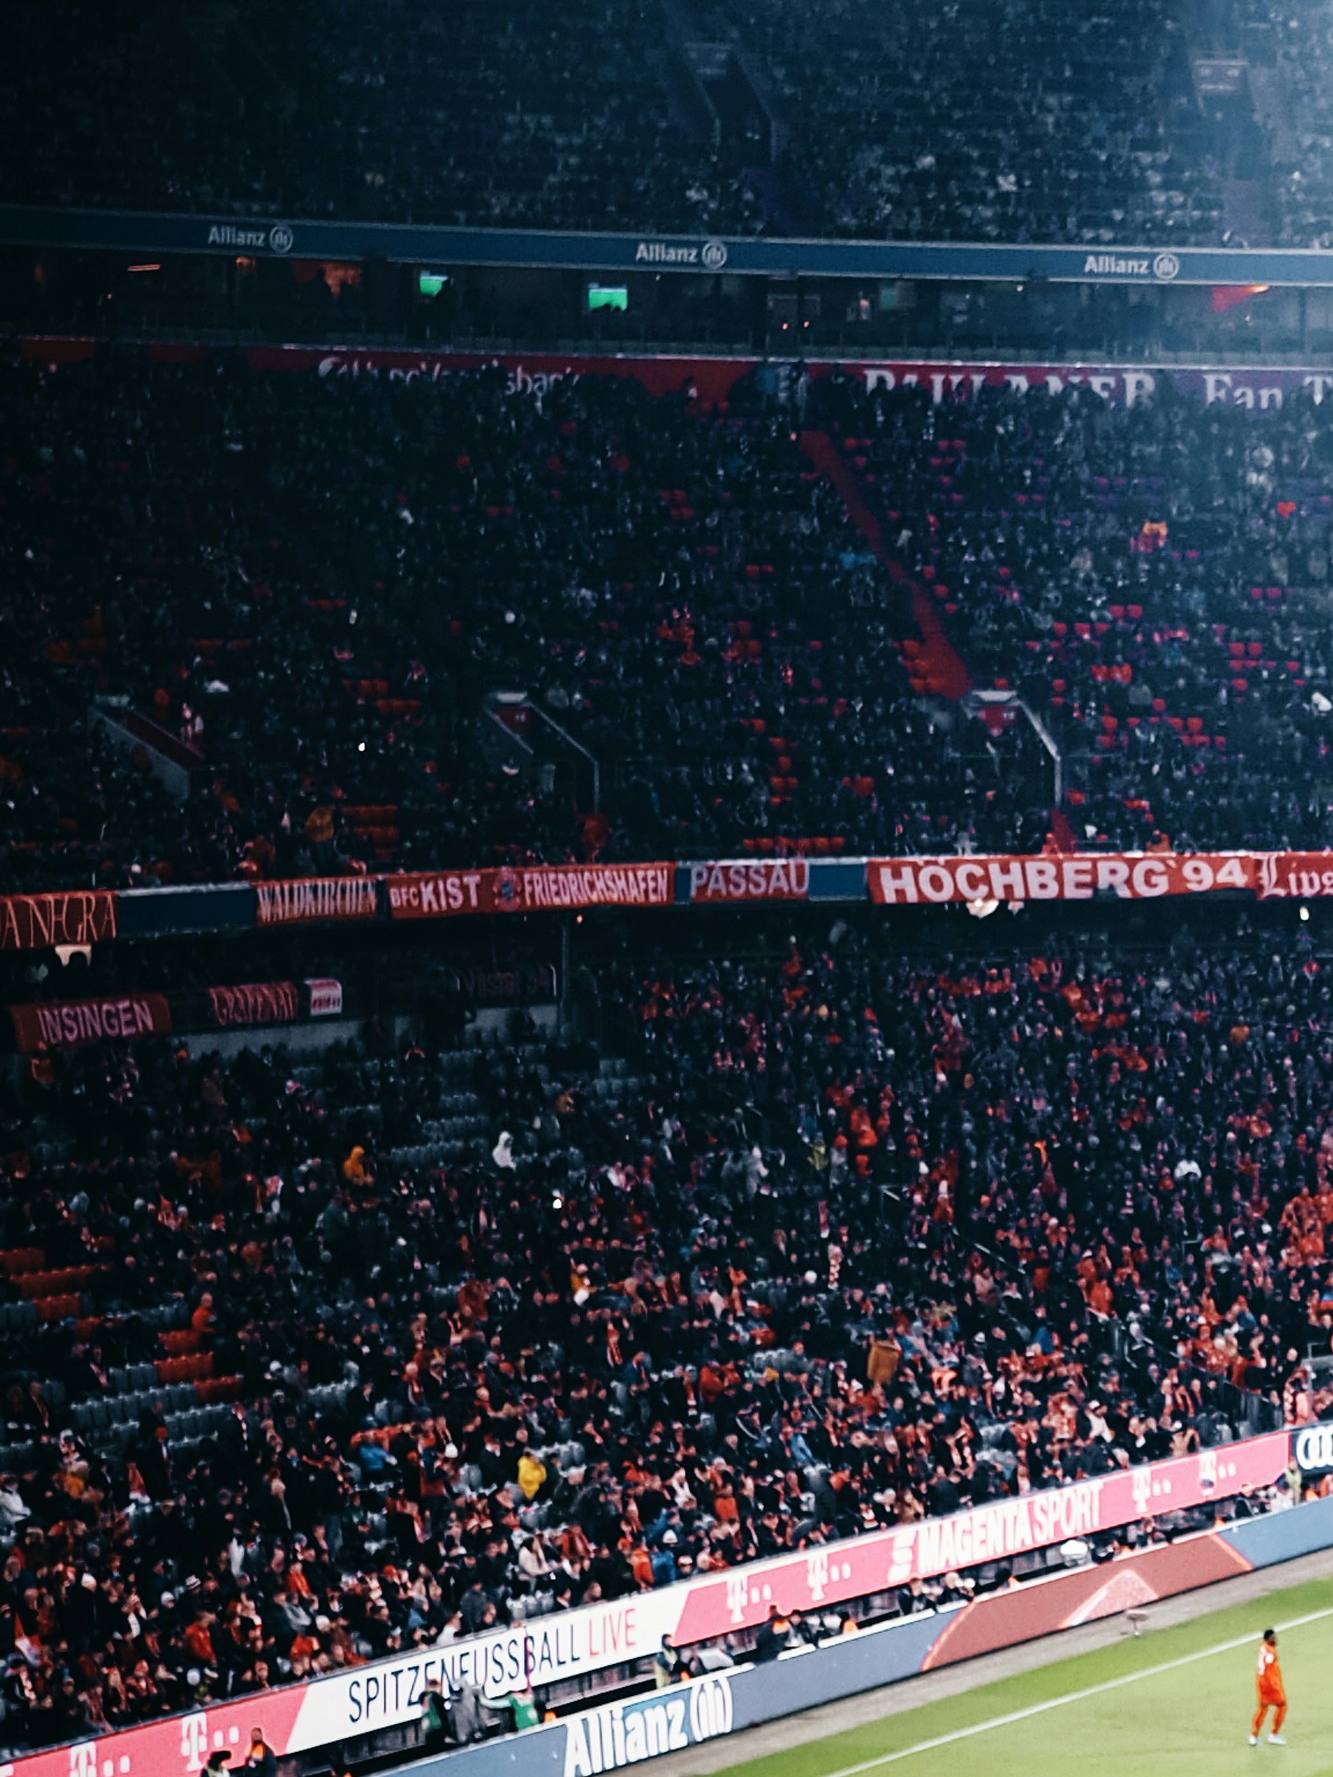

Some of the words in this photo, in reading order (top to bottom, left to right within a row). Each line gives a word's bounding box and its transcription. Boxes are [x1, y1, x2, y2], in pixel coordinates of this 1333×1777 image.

[207, 225, 267, 247] Allianz
[635, 242, 699, 264] Allianz
[1084, 255, 1149, 275] Allianz
[1204, 373, 1284, 411] Fan
[391, 886, 419, 909] BFC
[420, 874, 482, 913] KIST
[523, 868, 669, 906] FRIEDRICHSHAFEN
[690, 860, 810, 898] PASSAU
[37, 998, 155, 1044] INSINGEN
[918, 1502, 1032, 1569] MAGENTA
[1033, 1482, 1104, 1543] SPORT
[588, 1608, 637, 1657] LIVE
